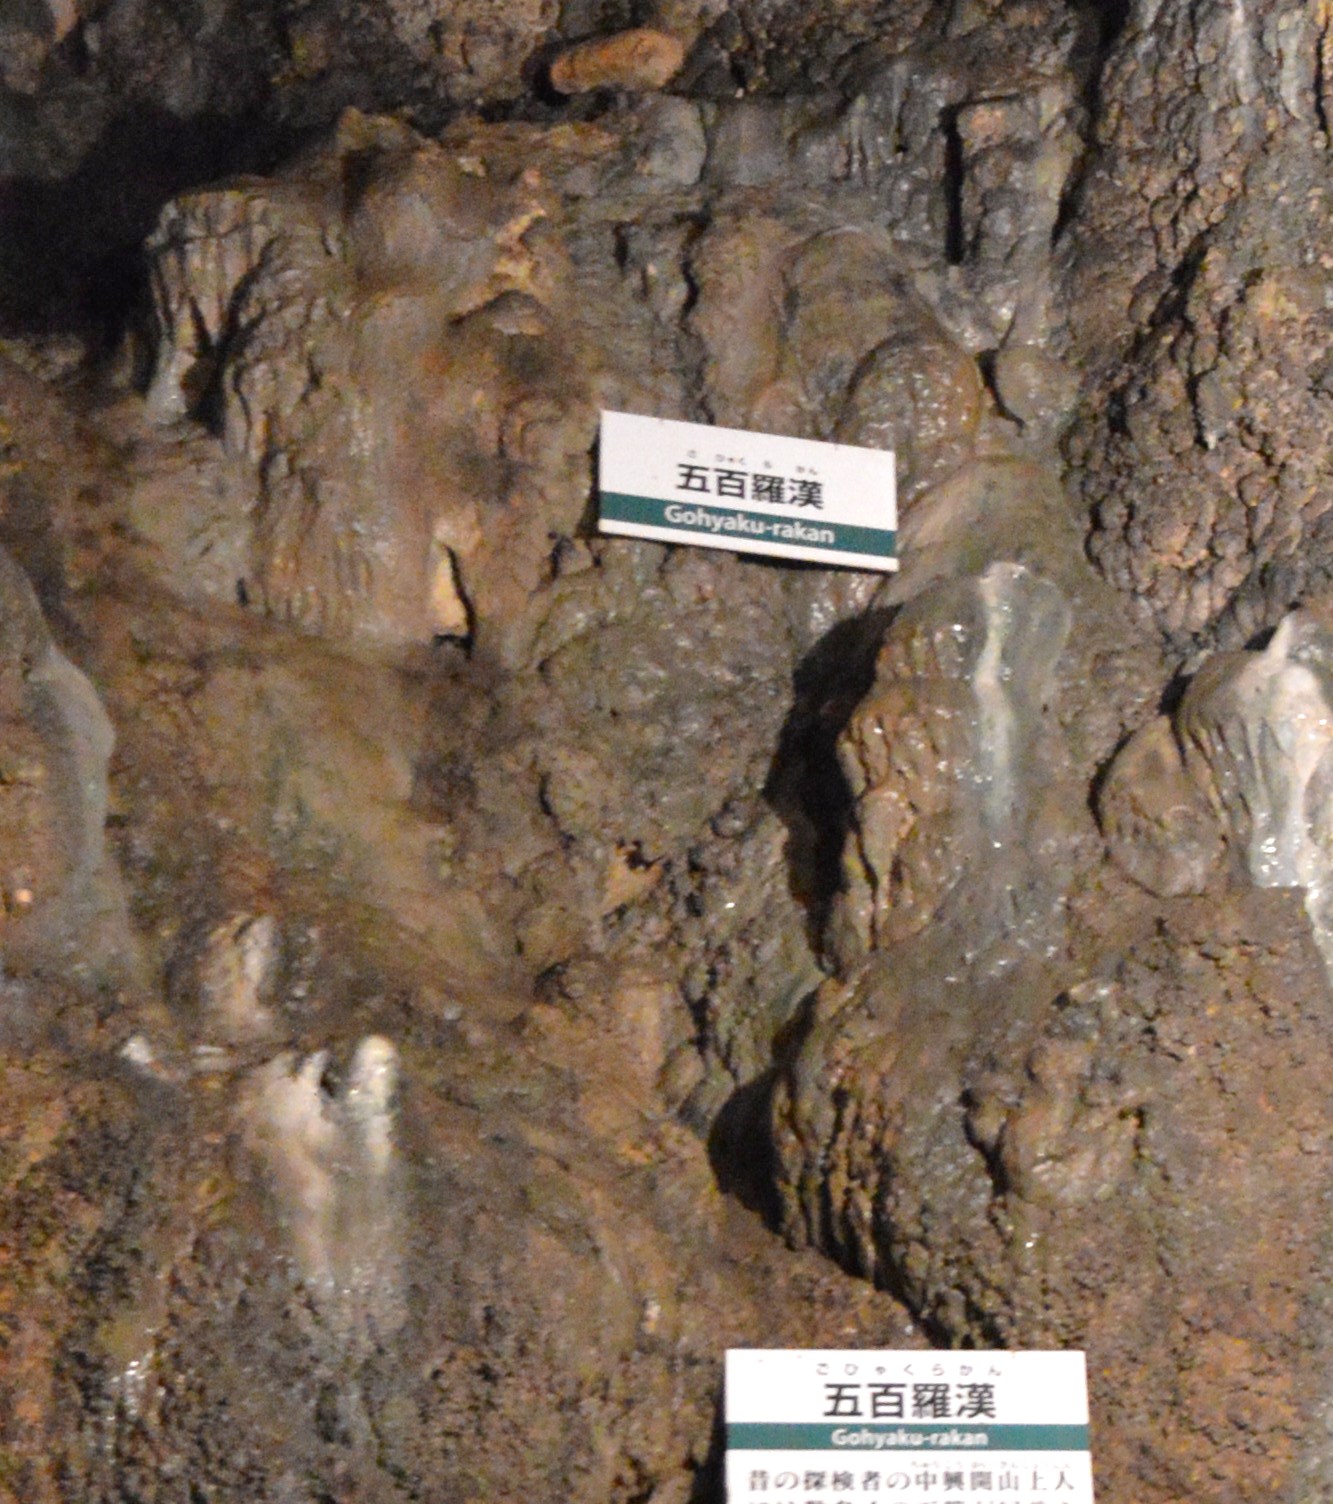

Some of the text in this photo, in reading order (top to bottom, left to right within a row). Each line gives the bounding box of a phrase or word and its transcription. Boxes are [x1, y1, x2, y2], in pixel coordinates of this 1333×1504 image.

[675, 462, 825, 511] 五百羅漢
[663, 504, 836, 544] Gohyaku-rakan
[822, 1382, 997, 1419] 五百羅漢
[831, 1428, 989, 1449] Gohyaku-rakan
